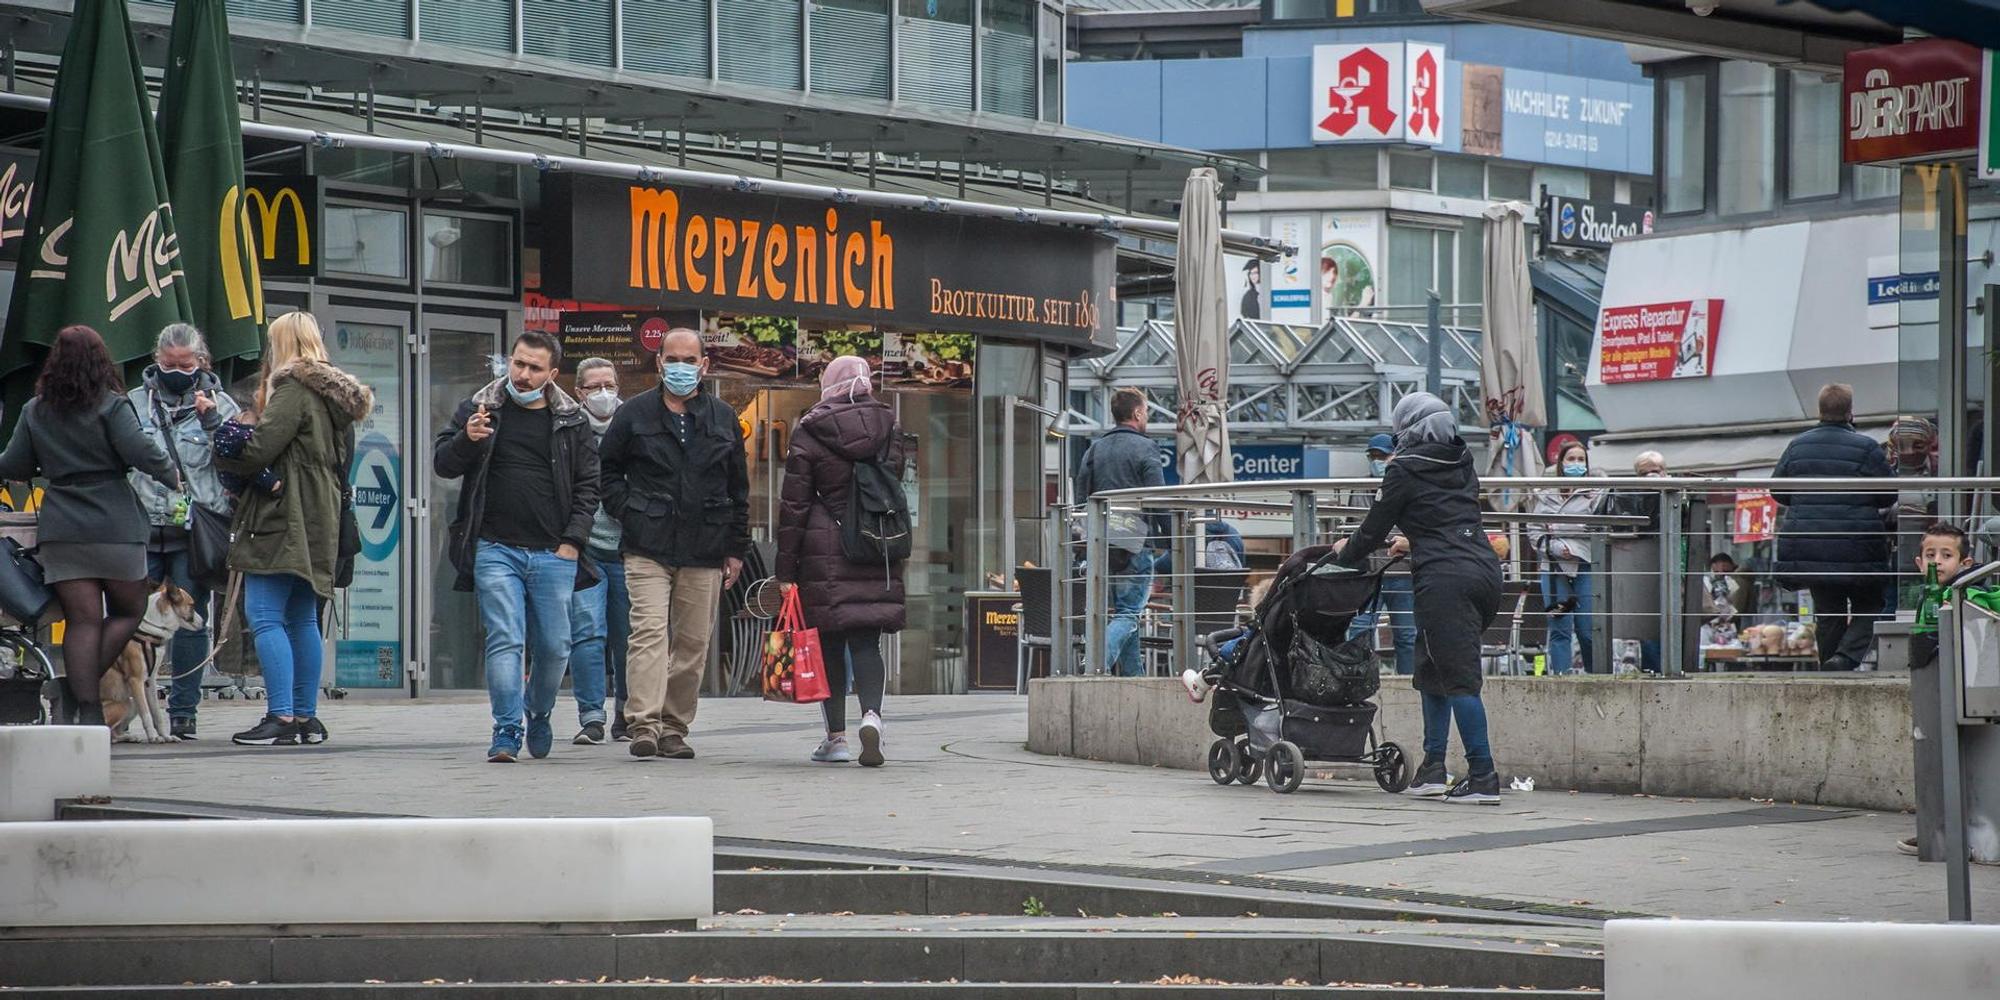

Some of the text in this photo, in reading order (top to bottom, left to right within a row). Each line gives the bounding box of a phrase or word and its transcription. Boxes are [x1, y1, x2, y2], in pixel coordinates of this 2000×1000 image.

[1505, 88, 1570, 119] NACHHILFE
[630, 186, 895, 311] Merzenich
[1043, 298, 1071, 327] SEIT
[1603, 306, 1685, 334] Express Reparatur
[564, 323, 632, 333] Unsere Merzenich
[564, 335, 604, 344] Butterbrot
[1233, 452, 1300, 474] Center
[368, 491, 391, 505] Meter
[986, 611, 1018, 624] Merze
